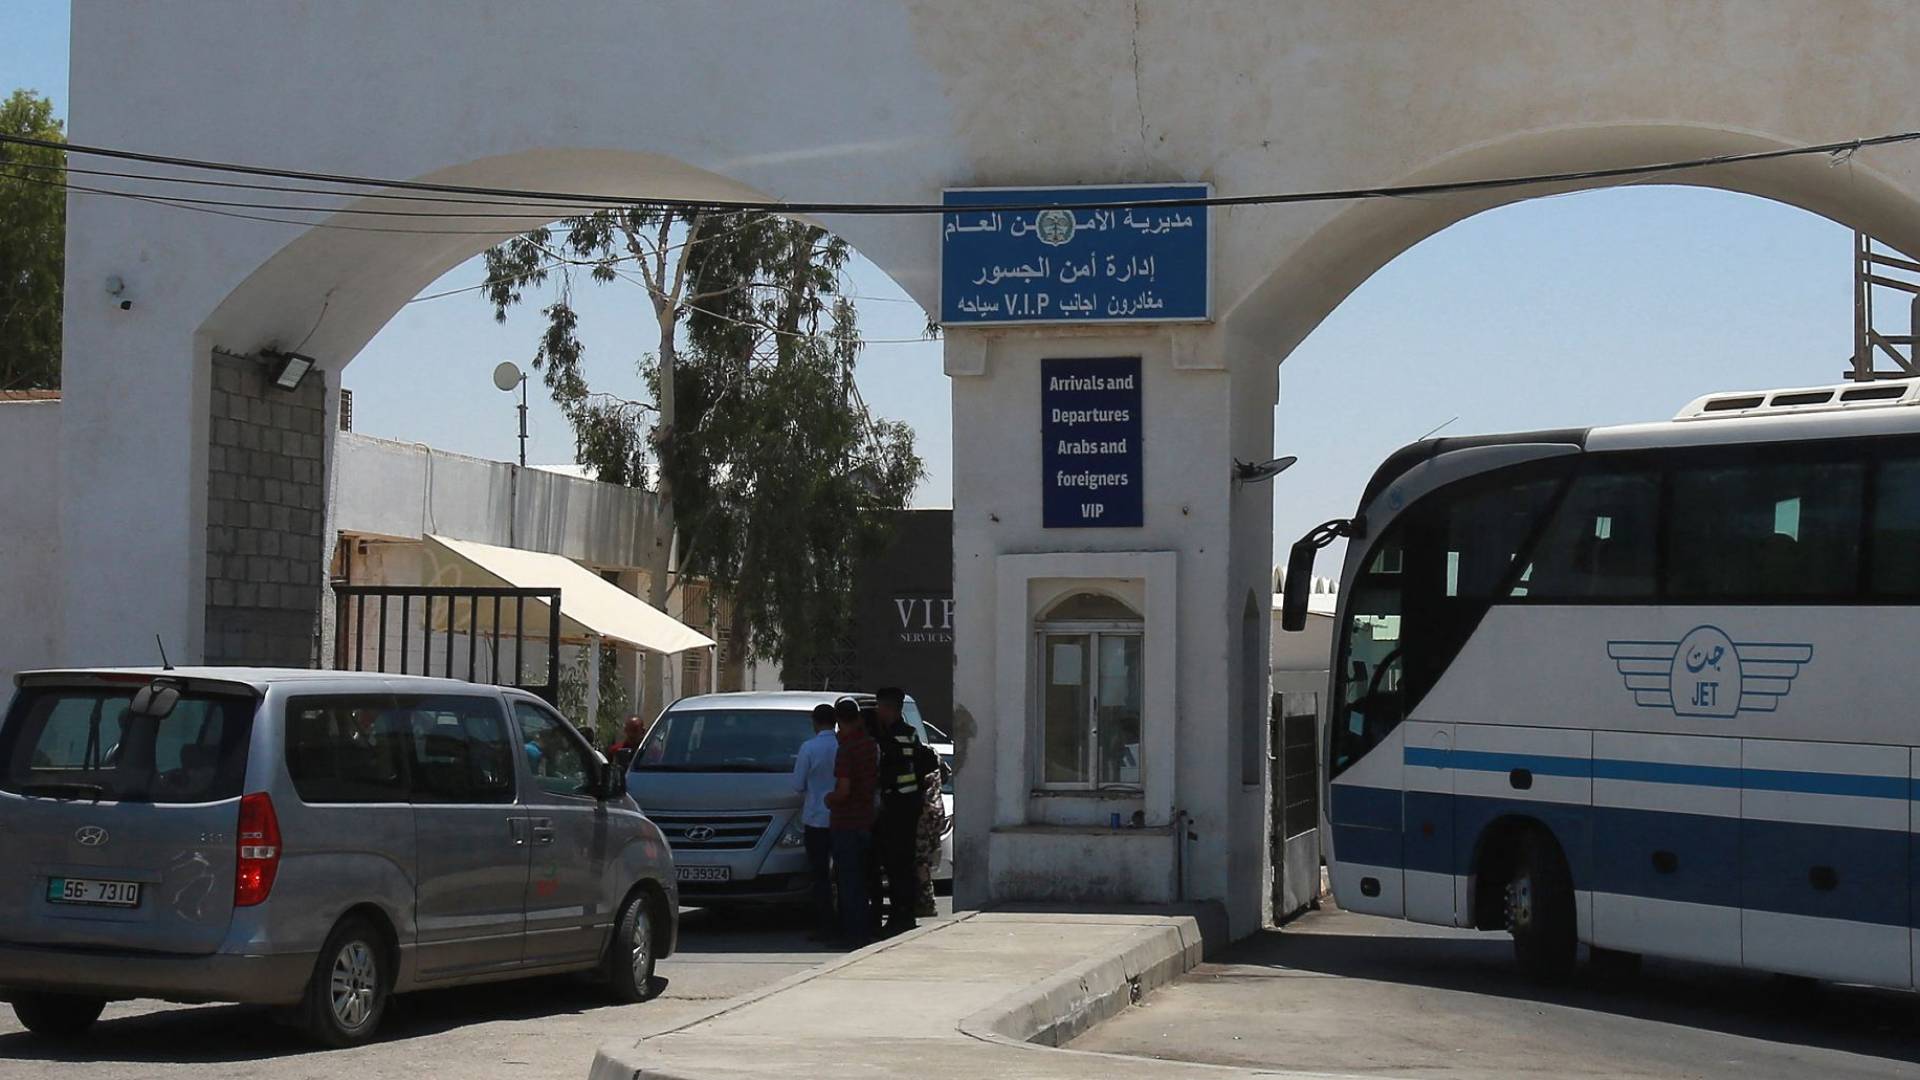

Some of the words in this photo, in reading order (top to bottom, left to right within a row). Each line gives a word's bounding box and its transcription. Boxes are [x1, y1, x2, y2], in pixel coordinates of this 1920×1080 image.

[945, 211, 1002, 242] العام
[1123, 208, 1193, 234] مديرية
[971, 256, 1050, 285] الجسور
[1059, 251, 1096, 284] أمن
[1106, 255, 1155, 283] إدارة
[1004, 293, 1050, 316] V.I.P
[1059, 292, 1097, 317] اجانب
[1107, 291, 1164, 316] مغادرون
[1050, 375, 1104, 391] Arrivals
[1106, 374, 1134, 390] and
[1052, 408, 1130, 426] Departures
[1058, 439, 1098, 455] Arabs
[1100, 438, 1127, 454] and
[1057, 470, 1129, 490] foreigners
[1081, 503, 1105, 518] VIP
[900, 632, 952, 643] SERVICES
[1691, 682, 1719, 706] JET
